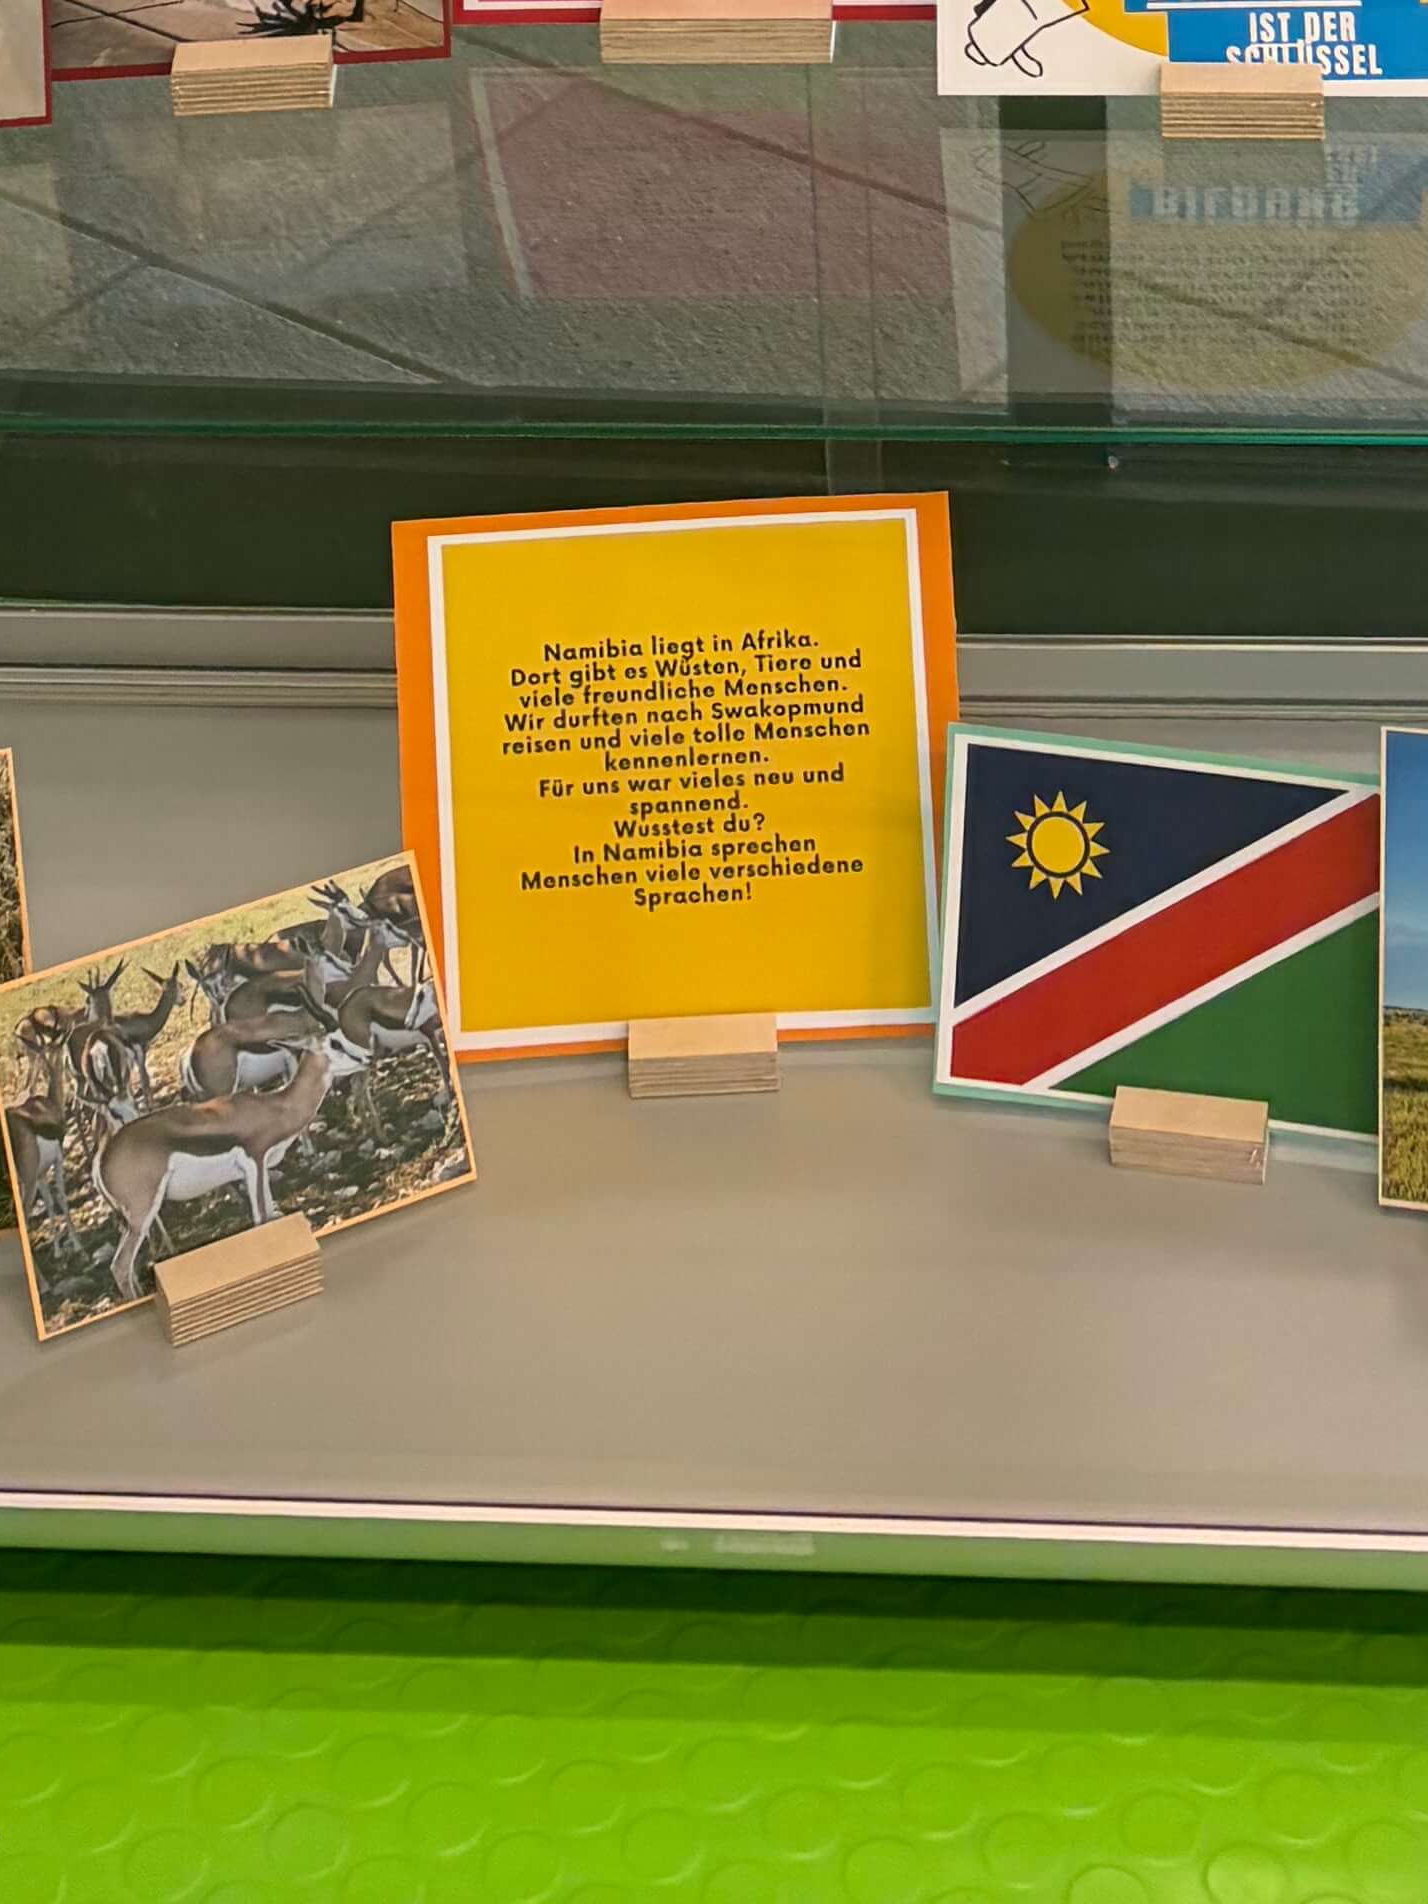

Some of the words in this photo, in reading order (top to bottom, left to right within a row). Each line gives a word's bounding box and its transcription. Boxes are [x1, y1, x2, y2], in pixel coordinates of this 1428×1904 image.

[1248, 12, 1291, 43] IST
[1303, 11, 1356, 43] DER
[544, 637, 644, 663] Namibia
[651, 634, 705, 664] liegt
[713, 633, 733, 652] in
[741, 628, 819, 651] Afrika.
[504, 713, 546, 732] Wir
[553, 706, 638, 730] durften
[647, 701, 703, 726] nach
[711, 693, 864, 726] Swakopmund
[539, 778, 575, 799] Für
[582, 780, 620, 796] uns
[627, 777, 672, 793] war
[679, 767, 746, 790] vieles
[753, 771, 794, 787] neu
[802, 761, 845, 784] und
[613, 814, 715, 839] Wusstest
[723, 812, 765, 833] du?
[634, 881, 752, 913] Sprachen!
